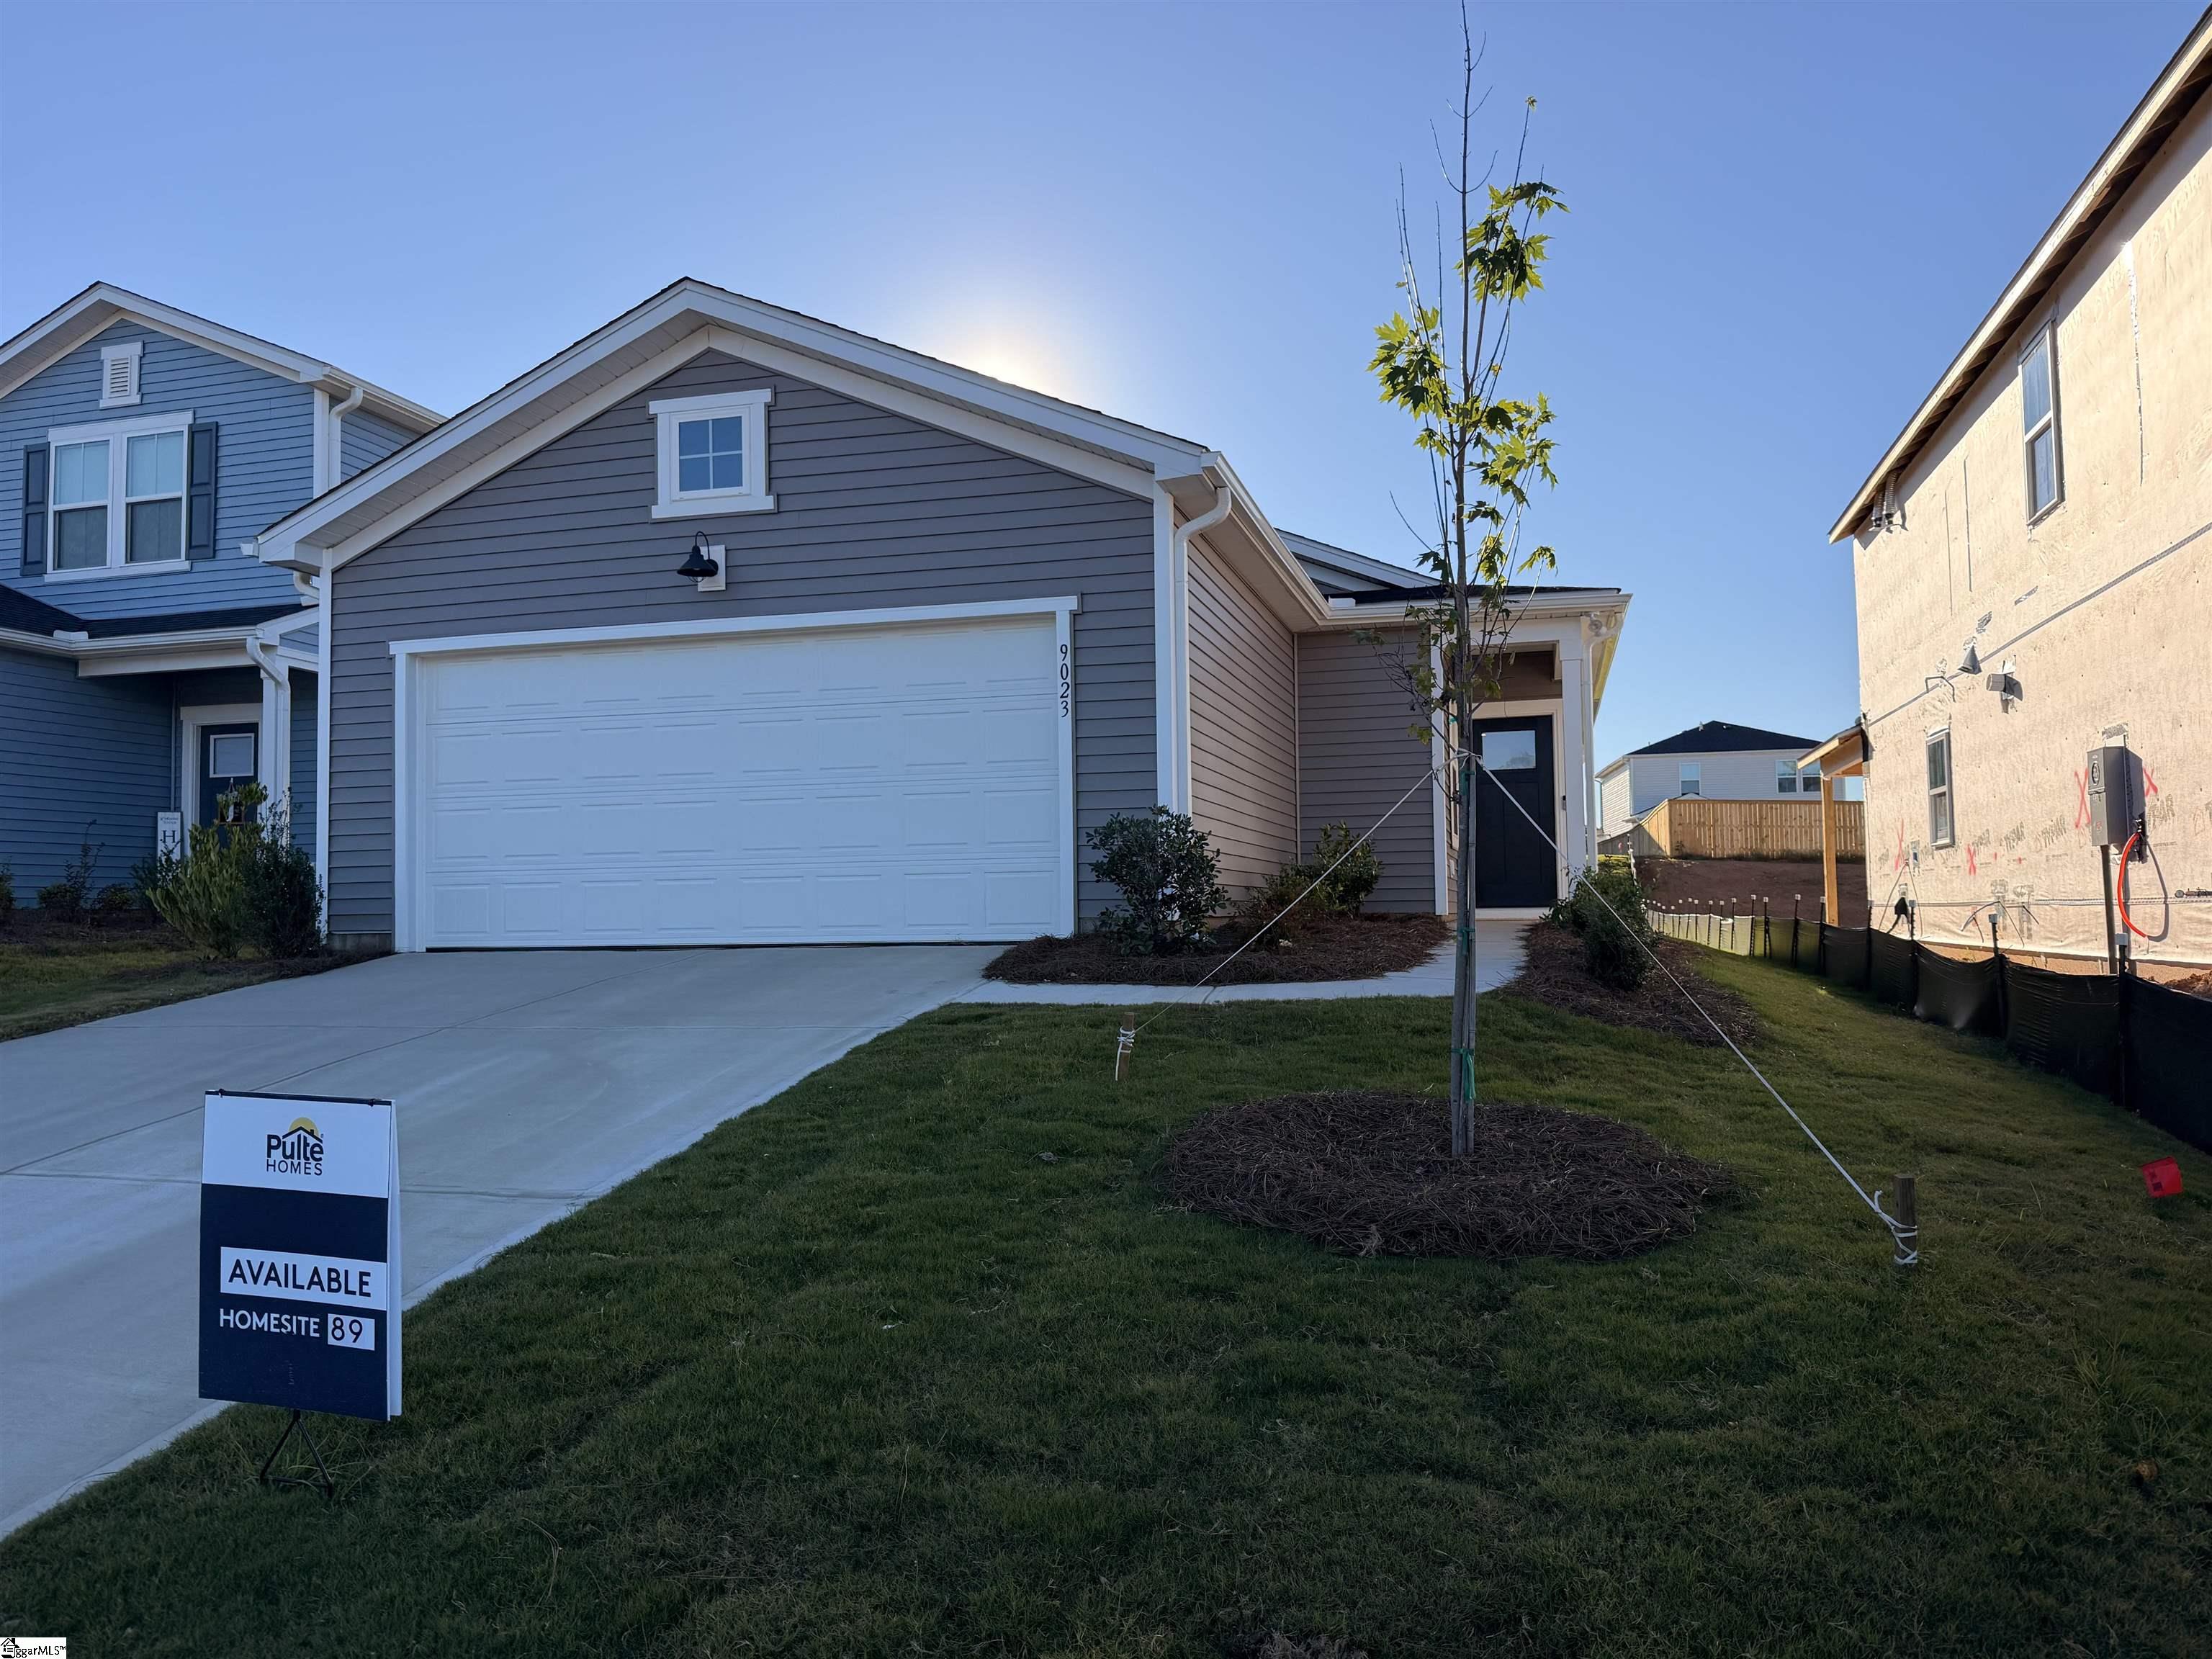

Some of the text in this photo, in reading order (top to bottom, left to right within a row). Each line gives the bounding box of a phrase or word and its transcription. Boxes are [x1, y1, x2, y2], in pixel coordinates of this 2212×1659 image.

[1059, 644, 1071, 718] 9023
[266, 1133, 324, 1162] Pulte
[266, 1159, 323, 1176] HOMES
[228, 1259, 372, 1298] AVAILABLE
[220, 1308, 363, 1344] HOMESITE 89
